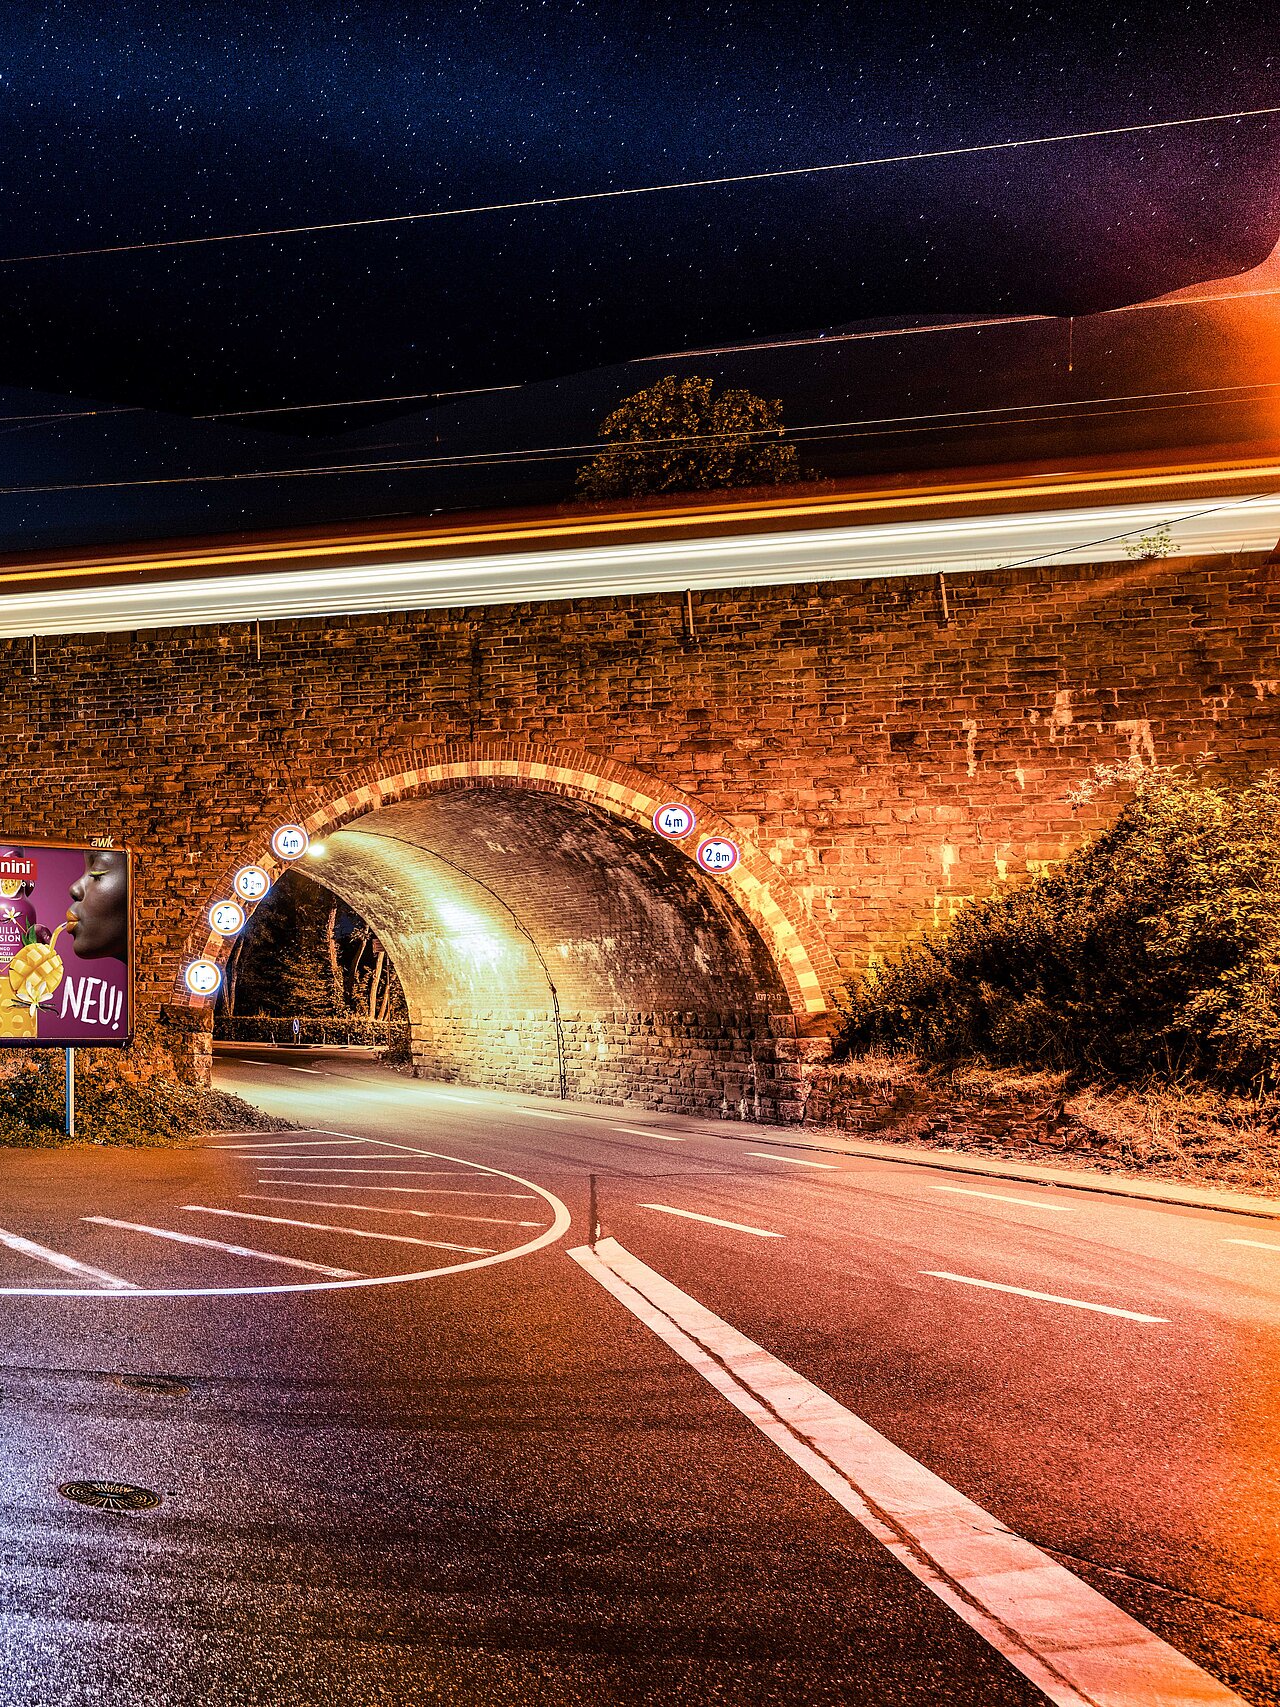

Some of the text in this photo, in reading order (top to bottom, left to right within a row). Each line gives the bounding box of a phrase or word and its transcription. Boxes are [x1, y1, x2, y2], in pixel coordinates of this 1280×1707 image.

[665, 814, 683, 828] 4m
[90, 836, 115, 848] awk
[282, 836, 299, 848] 4m
[60, 976, 123, 1031] NEU!
